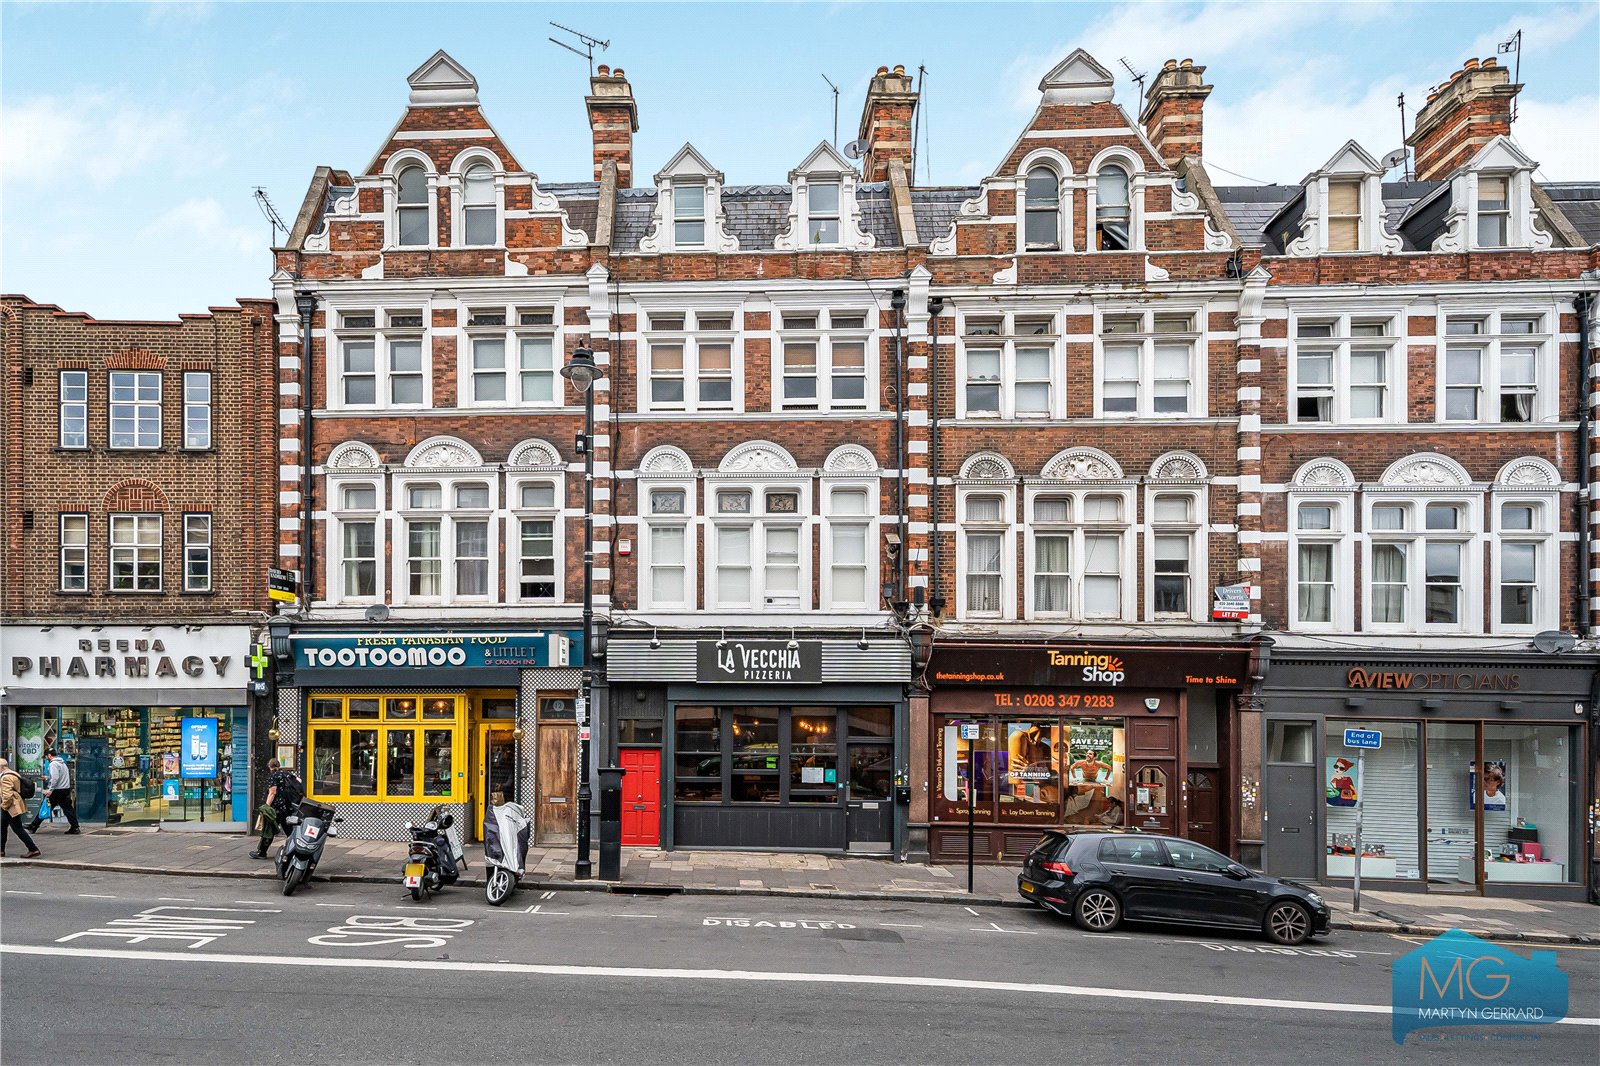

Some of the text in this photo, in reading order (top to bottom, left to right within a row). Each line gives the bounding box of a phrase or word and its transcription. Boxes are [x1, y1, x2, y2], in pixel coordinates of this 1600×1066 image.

[79, 639, 165, 652] REENA
[357, 637, 397, 646] FRESH
[402, 637, 464, 645] PANASIAN
[304, 647, 467, 667] TOOTOOMOO
[485, 647, 535, 657] & LITTLE T
[718, 644, 801, 673] LA VECCHIA
[1047, 651, 1109, 671] Tanning
[12, 656, 232, 677] PHARMACY
[744, 670, 792, 680] PIZZERIA
[936, 672, 1005, 682] thetanningshop.co.uk
[1082, 666, 1125, 686] Shop
[1185, 675, 1237, 684] Time to Shine
[994, 694, 1013, 707] TEL
[1023, 694, 1055, 707] 0208
[1058, 694, 1081, 708] 347
[1083, 695, 1115, 708] 9283
[973, 808, 991, 816] anning
[1035, 809, 1056, 818] Tanning
[409, 876, 417, 885] L
[702, 917, 858, 930] DISABLED
